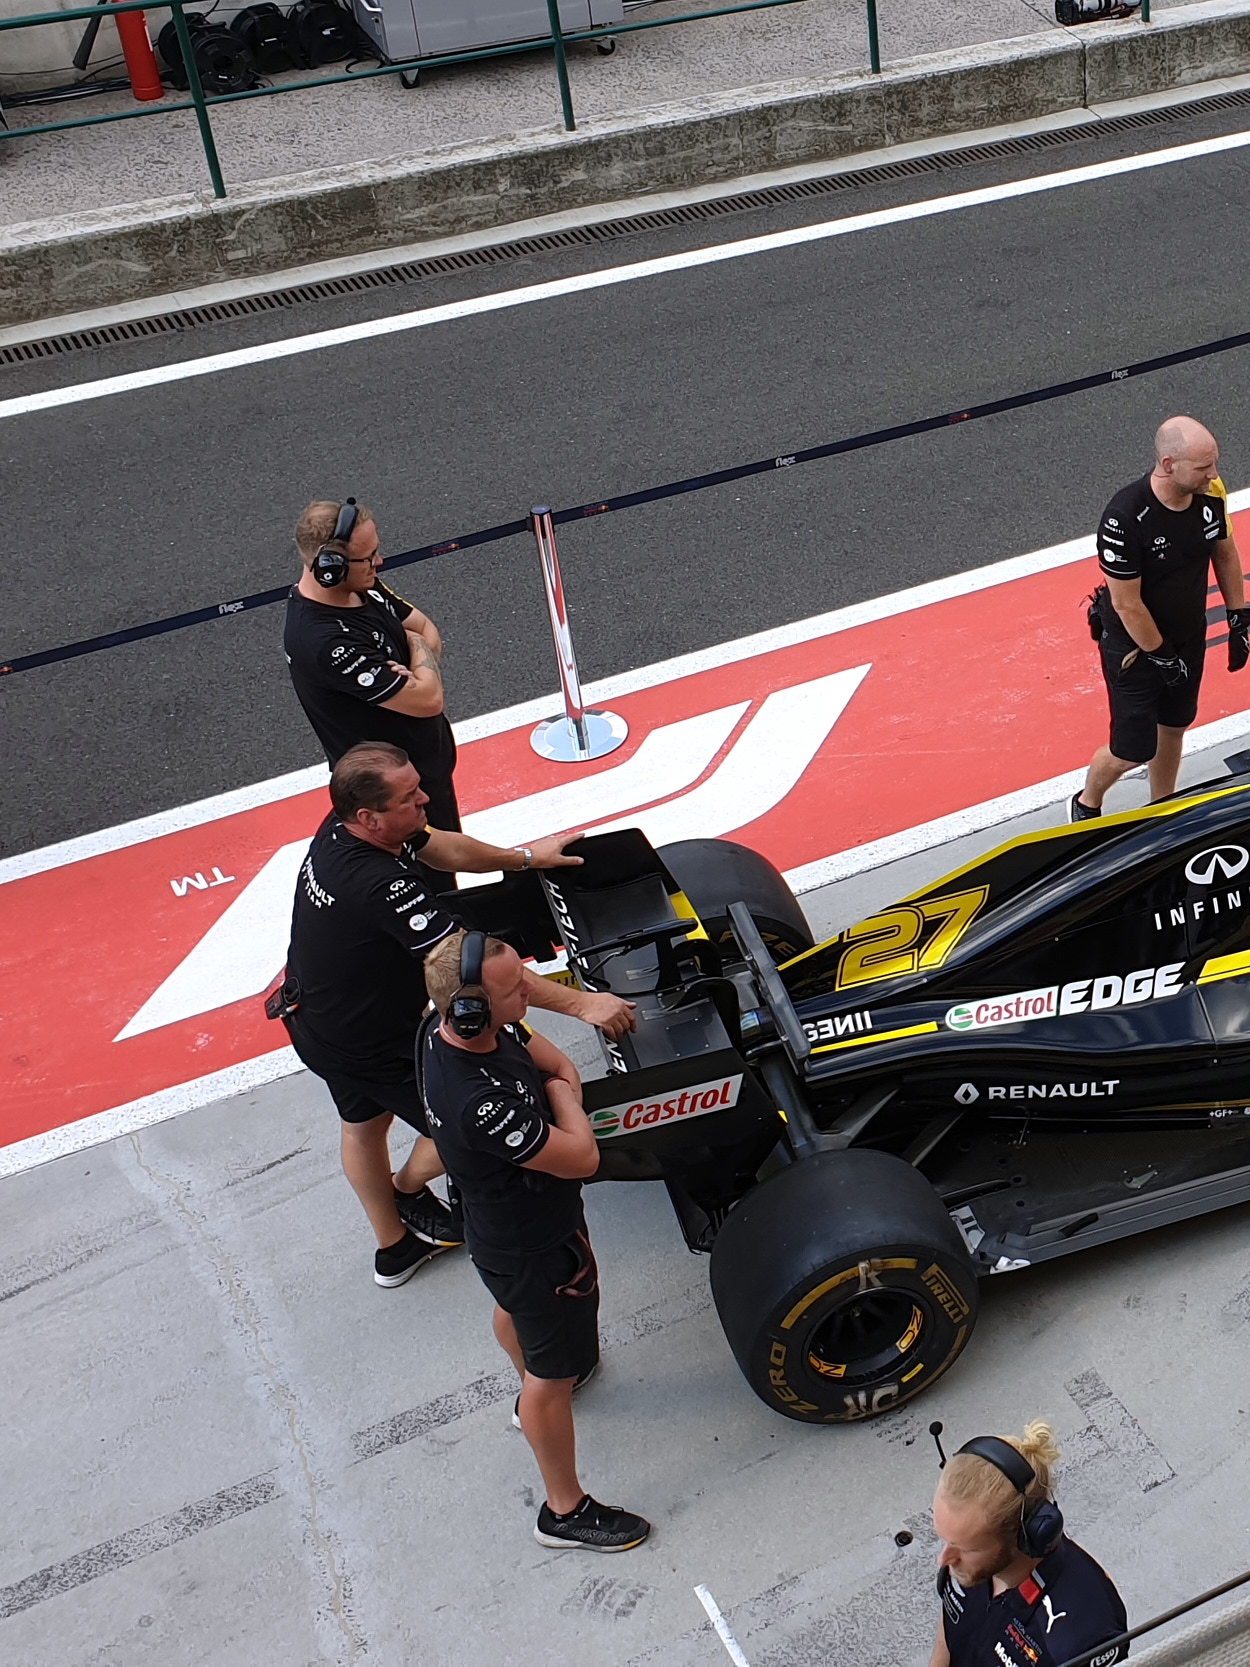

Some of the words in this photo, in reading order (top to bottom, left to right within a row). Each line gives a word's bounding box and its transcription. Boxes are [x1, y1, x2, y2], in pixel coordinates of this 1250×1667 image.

[218, 601, 245, 615] flex
[169, 866, 236, 897] TM
[834, 883, 992, 992] 27
[975, 991, 1054, 1025] Castrol
[1059, 961, 1187, 1016] EDGE
[623, 1081, 731, 1130] Castrol
[988, 1080, 1120, 1101] RENAULT
[920, 1262, 970, 1324] PIRELLI
[768, 1341, 819, 1414] ZERO
